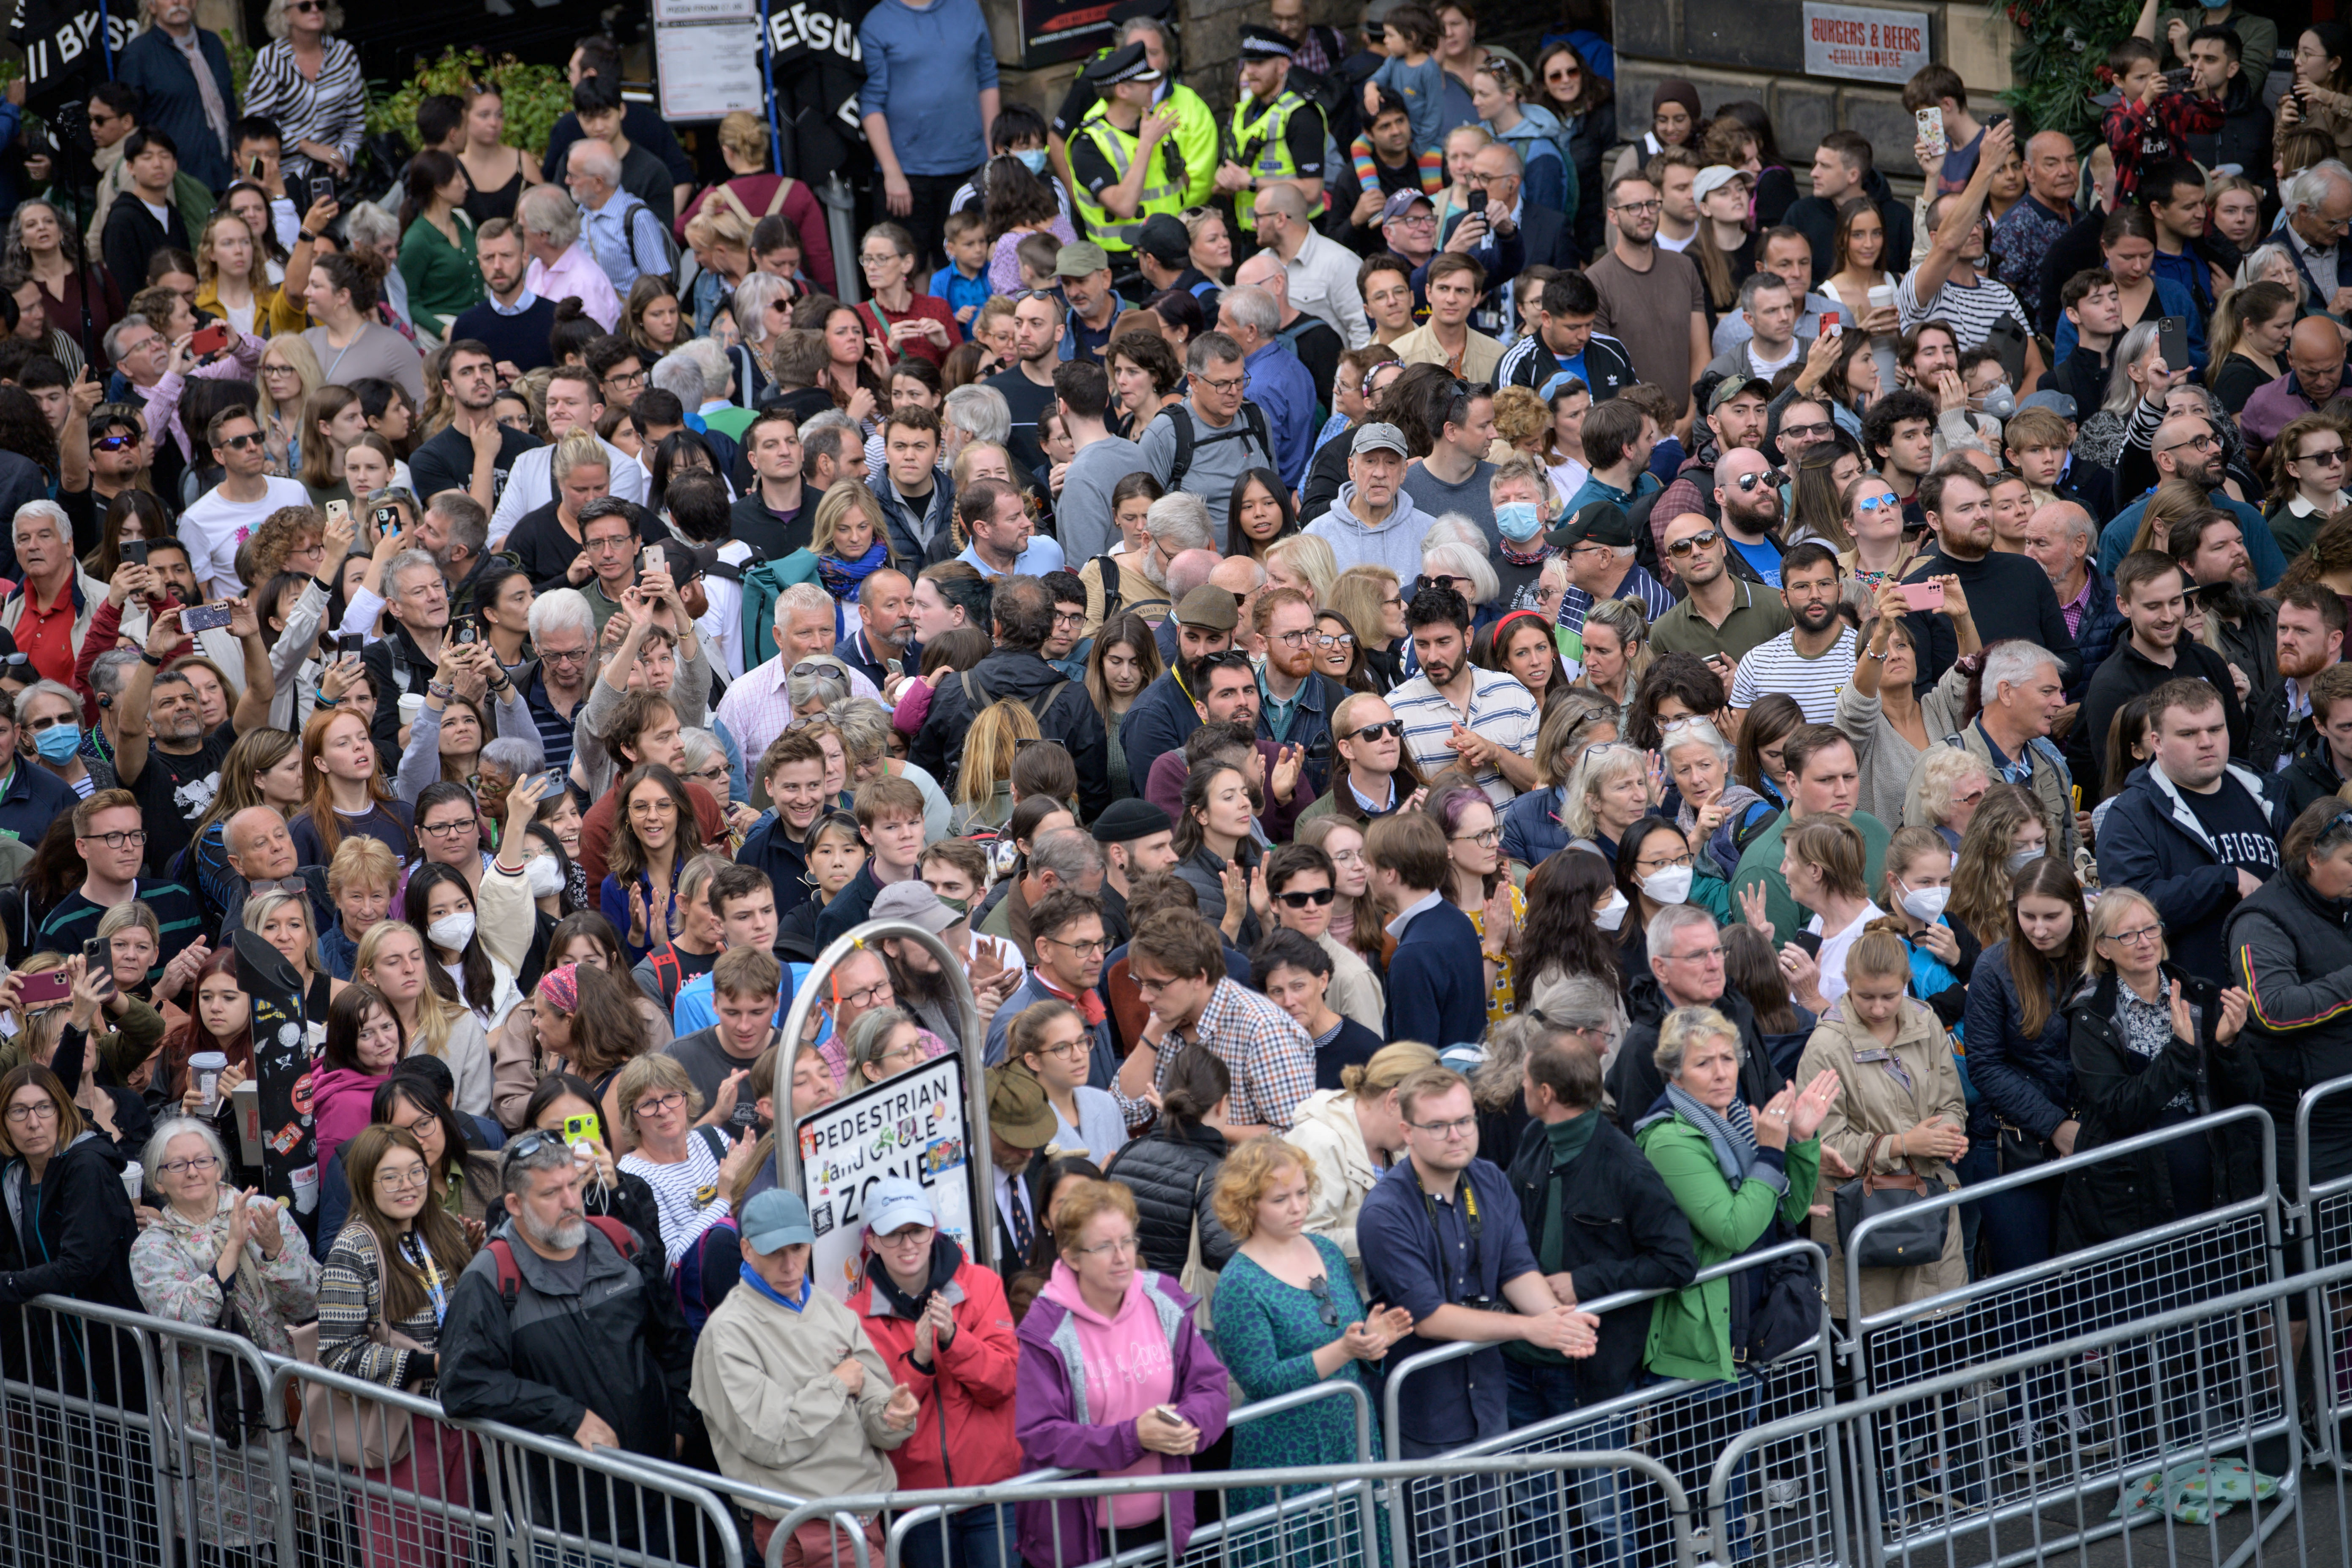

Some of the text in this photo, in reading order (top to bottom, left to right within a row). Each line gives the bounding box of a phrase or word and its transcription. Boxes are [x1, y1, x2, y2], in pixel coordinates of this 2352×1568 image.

[55, 10, 100, 64] BY
[1812, 17, 1920, 52] BURGERS & BEERS
[1833, 49, 1902, 68] GRILLHOUSE
[815, 1075, 947, 1155] PEDESTRIAN
[1465, 1188, 1476, 1215] Nikon
